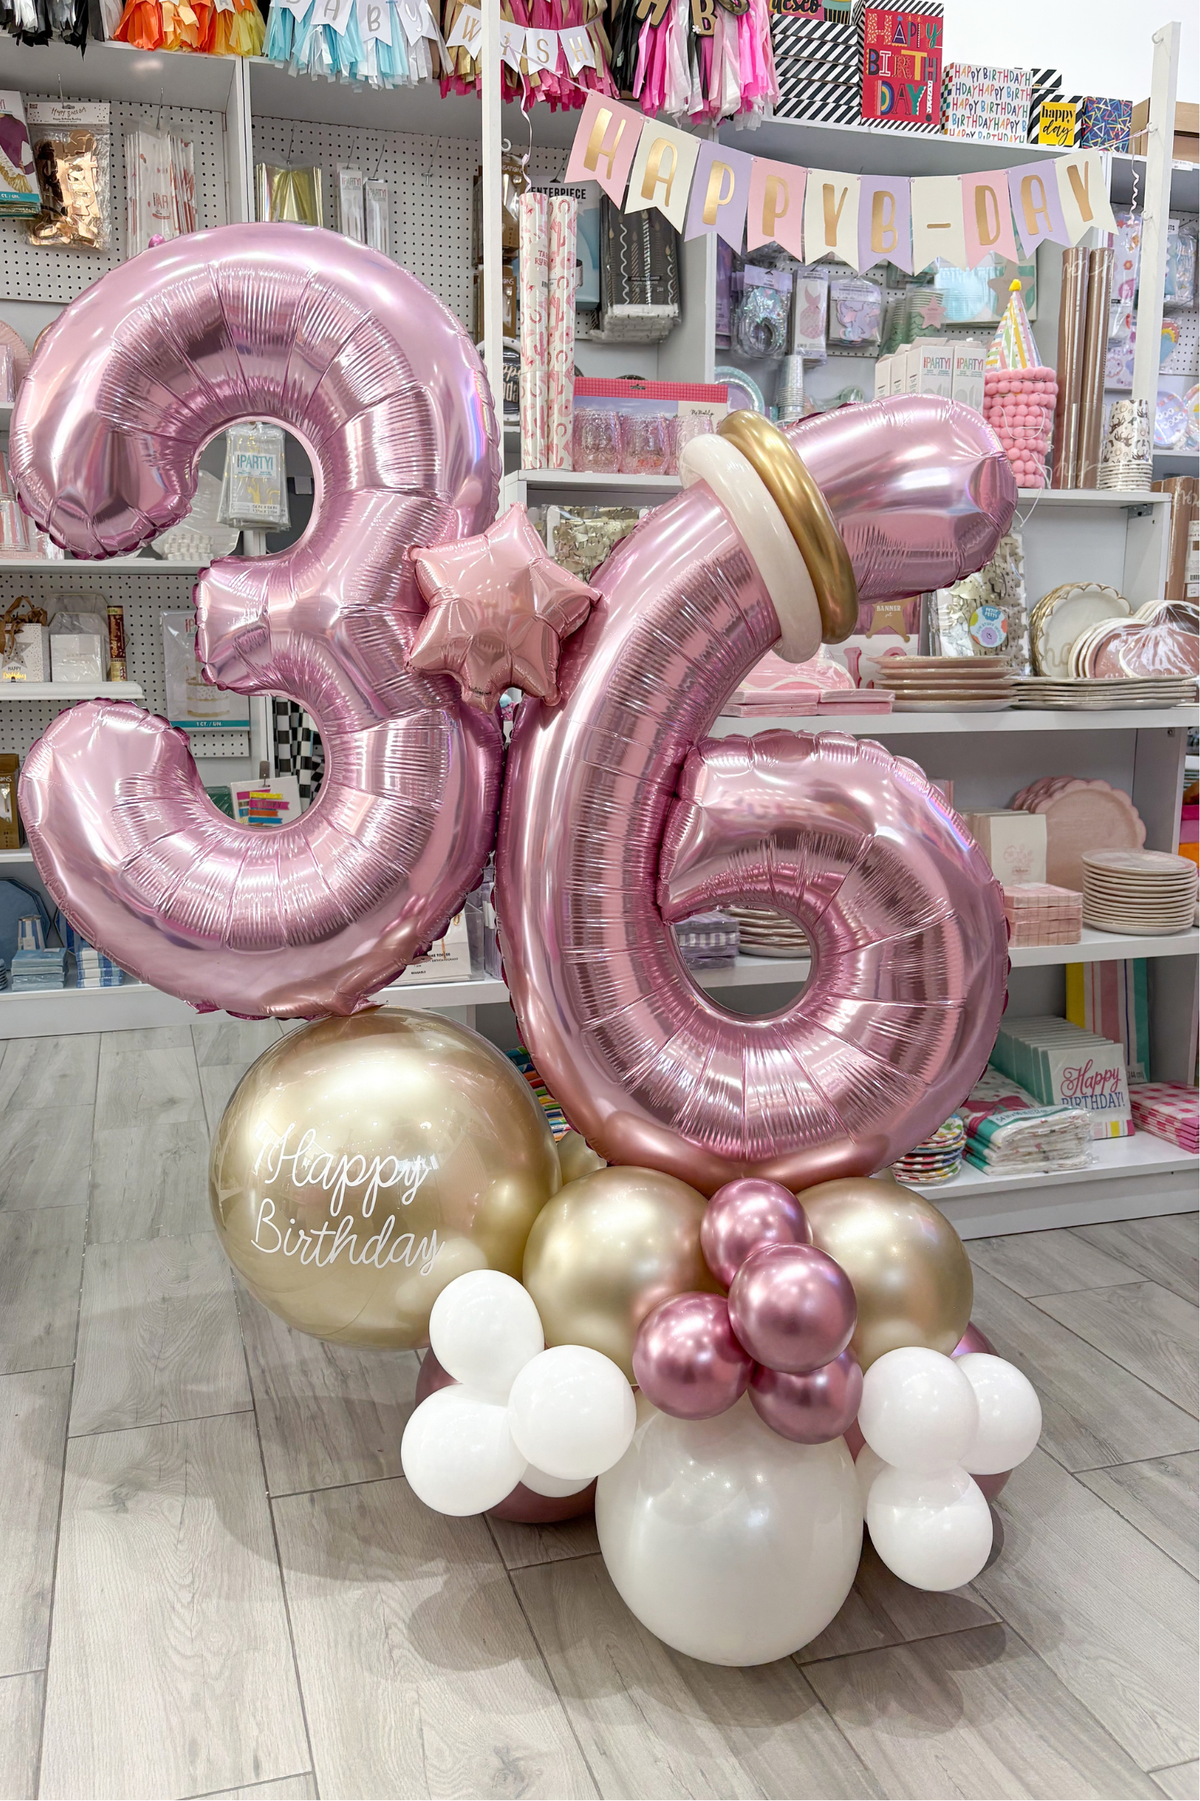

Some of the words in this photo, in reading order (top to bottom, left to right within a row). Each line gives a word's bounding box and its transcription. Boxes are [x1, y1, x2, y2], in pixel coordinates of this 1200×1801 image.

[866, 48, 938, 82] BIRTH
[1042, 105, 1075, 123] happy
[1043, 119, 1073, 146] day
[584, 107, 848, 247] HAPPY
[1060, 1058, 1121, 1098] Happy
[264, 1122, 430, 1218] Happy
[250, 1197, 445, 1276] Birthday
